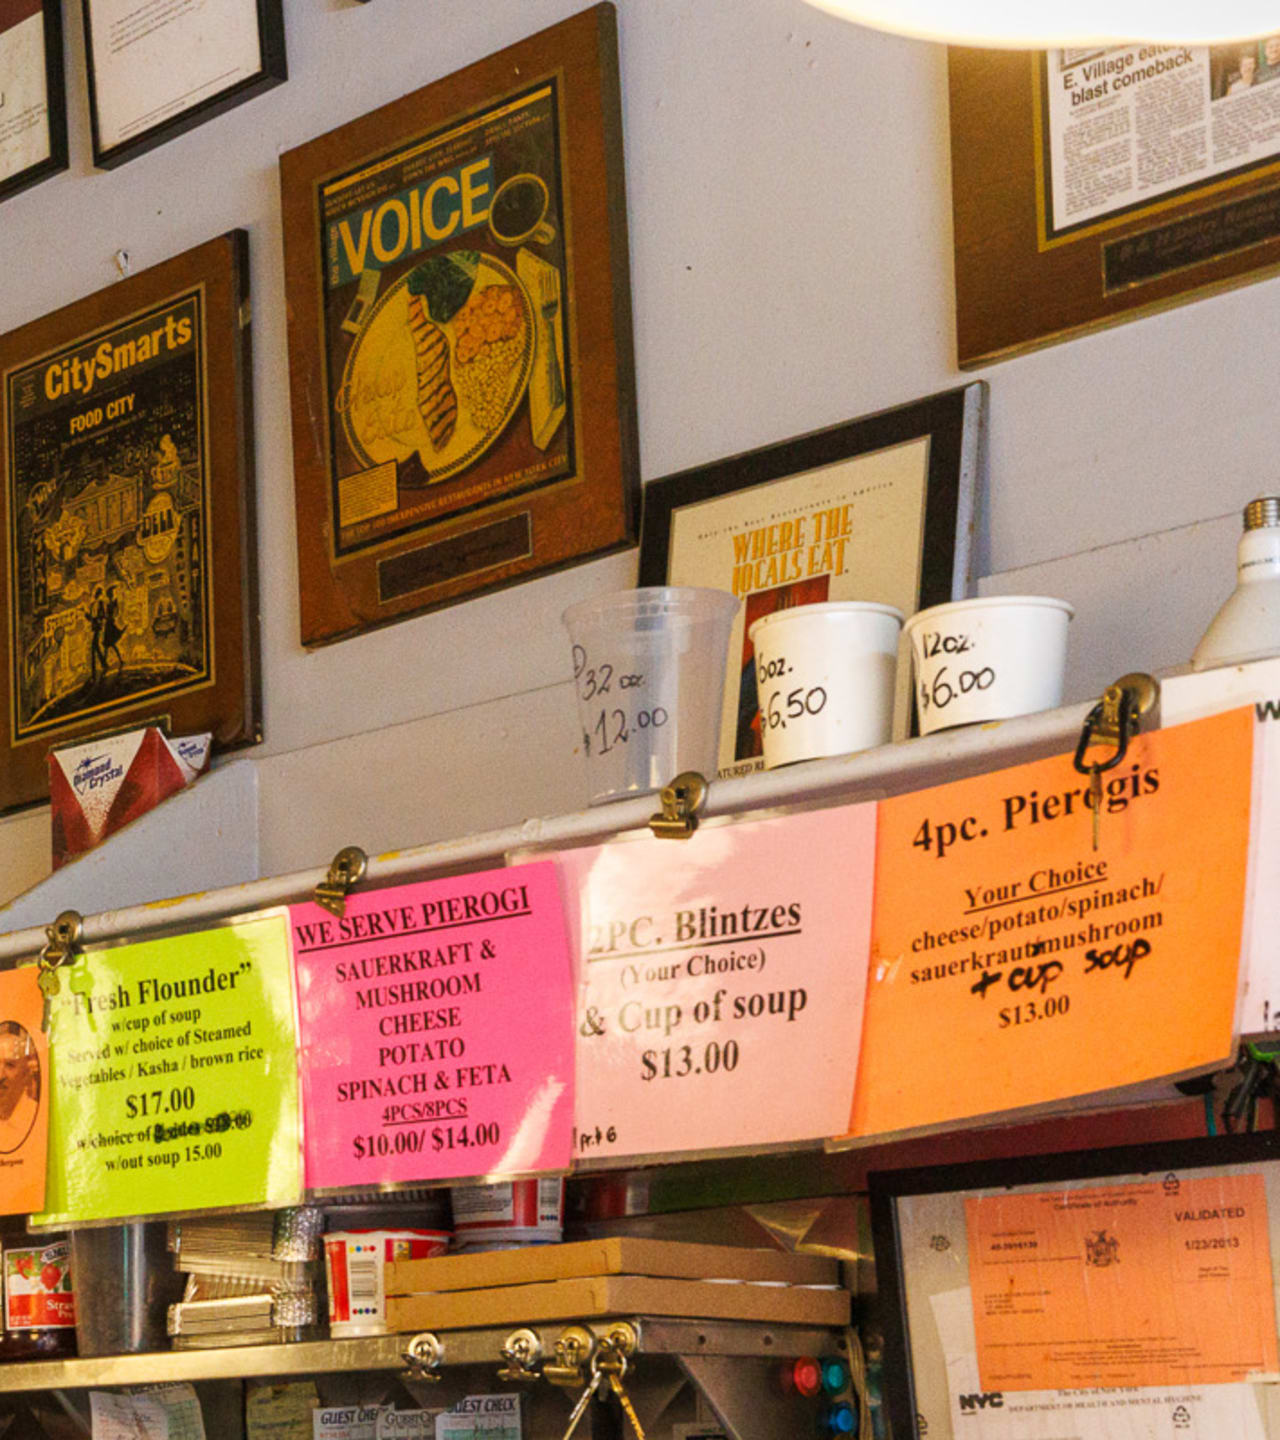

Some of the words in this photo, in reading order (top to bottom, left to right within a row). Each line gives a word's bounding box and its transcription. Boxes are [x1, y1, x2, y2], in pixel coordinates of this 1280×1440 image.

[1071, 79, 1108, 108] blast
[1112, 48, 1194, 90] comeback
[1082, 51, 1134, 83] Village
[339, 156, 490, 277] VOICE
[44, 315, 193, 401] CitySmarts
[69, 408, 104, 436] FOOD
[106, 393, 136, 421] CITY
[732, 514, 808, 565] WHERE
[813, 503, 856, 543] THE
[920, 667, 997, 711] $6.00
[90, 765, 123, 789] Crystal
[913, 818, 989, 858] 4pc.
[1002, 763, 1161, 834] Pierogis
[963, 881, 1022, 909] Your
[1028, 858, 1109, 896] Choice
[296, 921, 336, 949] WE
[338, 905, 417, 942] SERVE
[422, 885, 531, 928] PIEROGI
[590, 914, 664, 955] 2PC.
[674, 901, 803, 943] Blintzes
[911, 872, 1165, 954] cheese/potato/spinach/
[334, 940, 474, 984] SAUERKRAFT
[478, 938, 498, 961] &
[619, 961, 682, 991] (Your
[686, 947, 767, 979] Choice)
[1008, 960, 1064, 995] cup
[1083, 937, 1152, 980] soup
[354, 971, 482, 1011] MUSHROOM
[168, 1006, 203, 1028] soup
[378, 1005, 463, 1038] CHEESE
[579, 1004, 606, 1039] &
[617, 999, 683, 1037] Cup
[693, 988, 727, 1025] of
[732, 985, 809, 1022] soup
[997, 994, 1071, 1030] $13.00
[131, 1034, 174, 1055] choice
[193, 1020, 253, 1045] Steamed
[377, 1036, 467, 1068] POTATO
[136, 1058, 180, 1080] Kasha
[189, 1048, 235, 1071] brown
[237, 1044, 265, 1064] rice
[640, 1039, 741, 1082] $13.00
[124, 1085, 196, 1120] $17.00
[336, 1072, 428, 1103] SPINACH
[433, 1069, 450, 1091] &
[455, 1063, 513, 1089] FETA
[146, 1148, 181, 1169] soup
[184, 1142, 223, 1164] 15.00
[430, 1121, 502, 1153] $14.00
[1175, 1207, 1245, 1222] VALIDATED
[320, 1412, 357, 1425] GUEST
[483, 1398, 517, 1413] CHECK
[959, 1391, 1004, 1410] NYC
